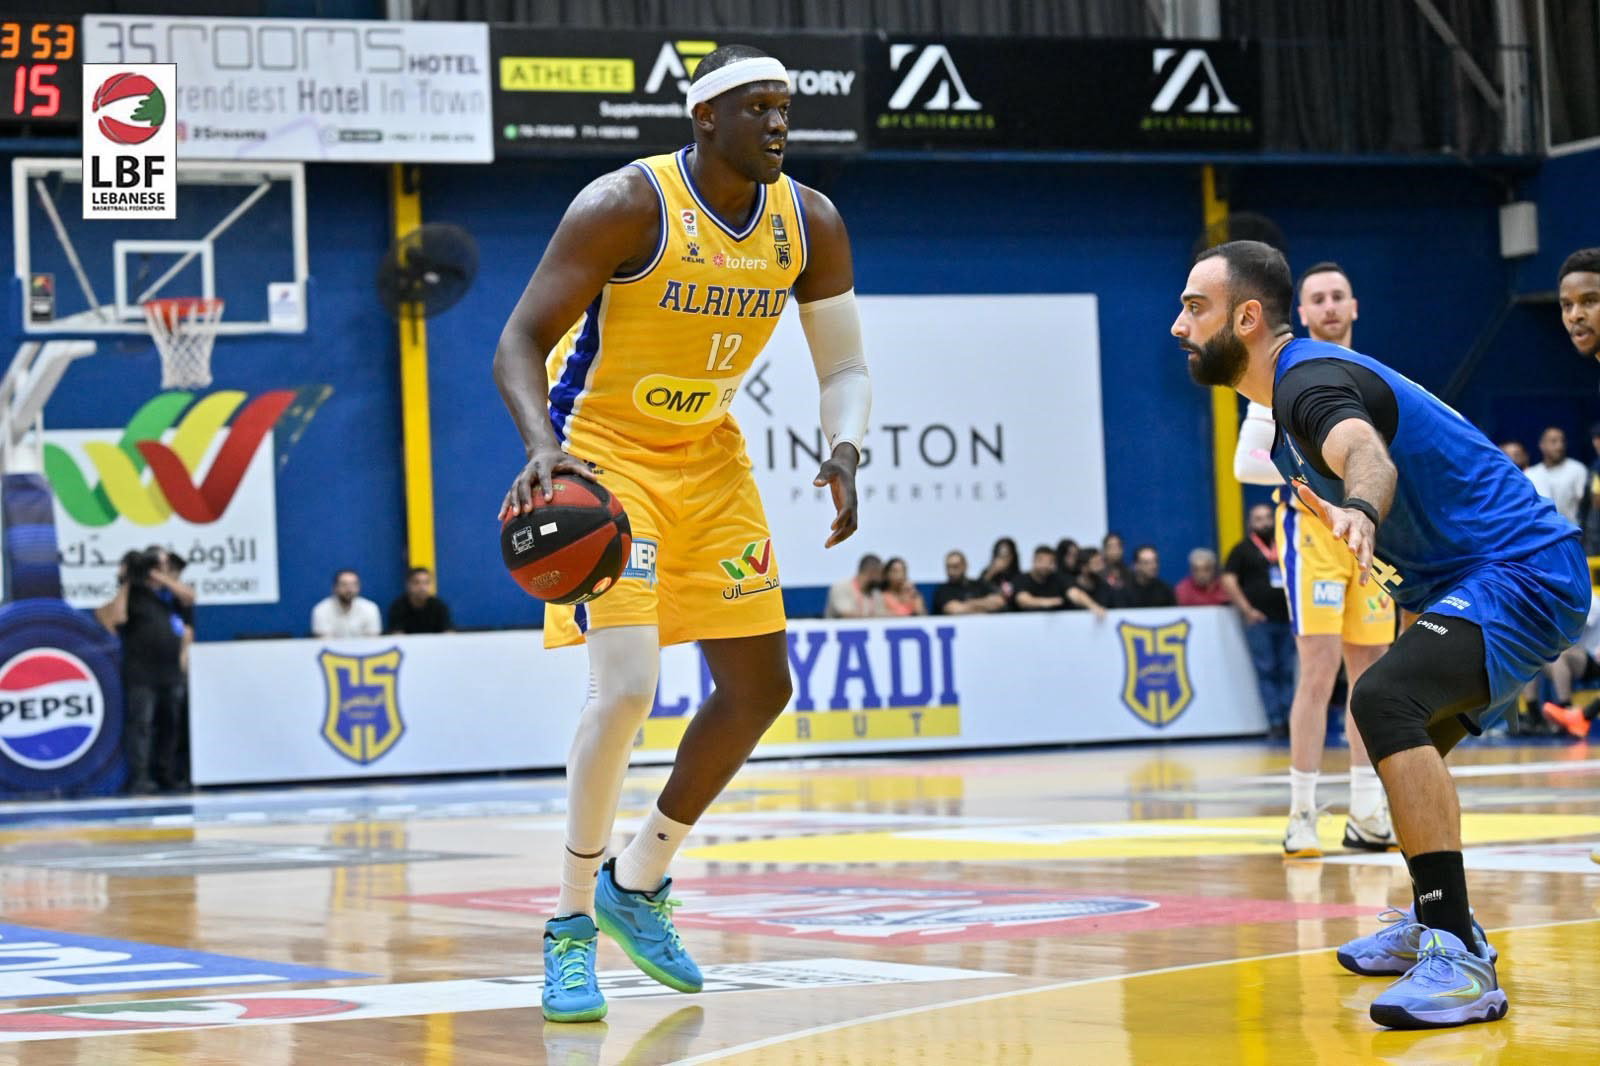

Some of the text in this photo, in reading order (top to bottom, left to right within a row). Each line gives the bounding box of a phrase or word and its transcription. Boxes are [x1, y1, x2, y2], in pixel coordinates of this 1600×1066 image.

[408, 55, 479, 74] HOTEL
[509, 63, 626, 83] ATHLETE
[14, 64, 61, 117] 15
[786, 69, 856, 95] TORY
[178, 79, 485, 115] rendiest Hotel In Town
[877, 113, 996, 130] architects
[681, 256, 705, 265] KELME
[726, 255, 768, 270] toters
[658, 280, 790, 319] ALRIYAD
[704, 331, 744, 372] 12
[645, 387, 712, 413] OMT
[790, 481, 1008, 501] PRPERTIES
[0, 694, 94, 723] PEPSI
